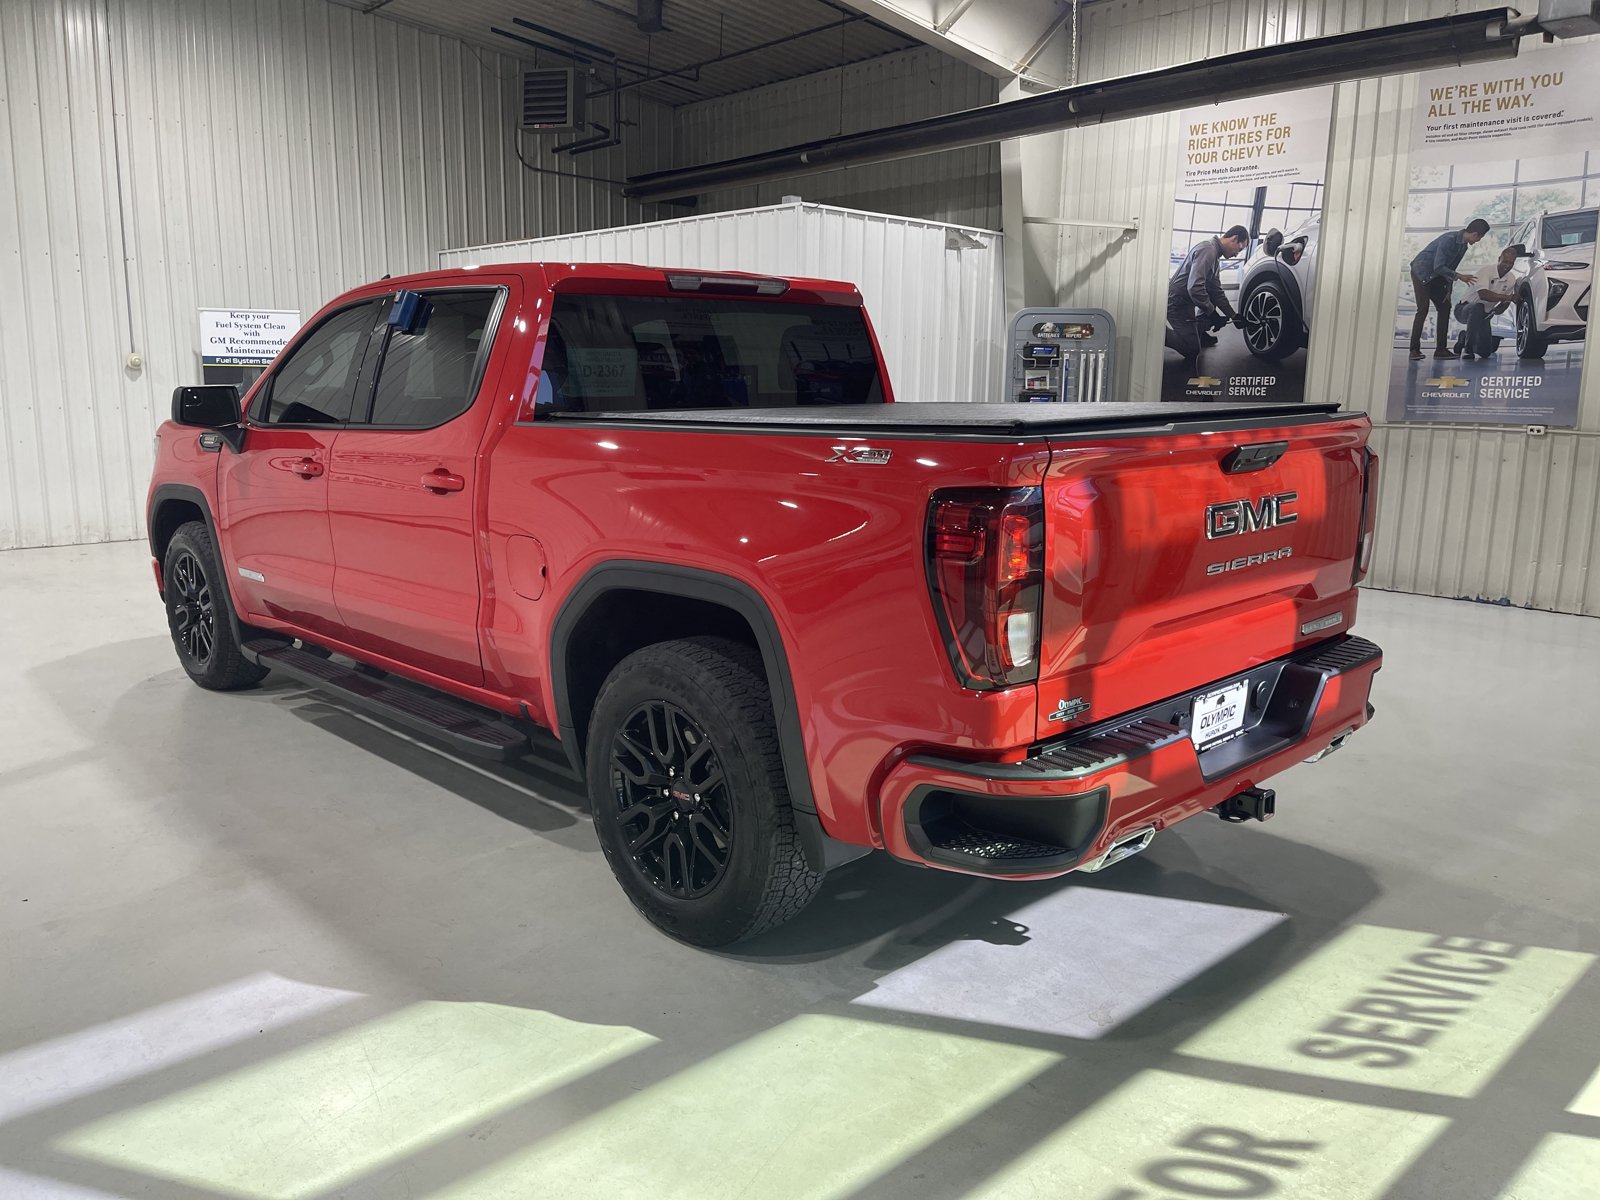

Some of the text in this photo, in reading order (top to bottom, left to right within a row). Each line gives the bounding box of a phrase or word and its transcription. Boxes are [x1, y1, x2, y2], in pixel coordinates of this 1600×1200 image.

[1430, 72, 1564, 101] WE'RE WITH YOU
[1427, 93, 1535, 118] ALL THE WAY.
[1190, 112, 1278, 136] WE KNOW THE
[1460, 118, 1504, 129] maintenance
[1506, 116, 1522, 124] visit
[1188, 126, 1291, 151] RIGHT TIRES FOR
[1187, 142, 1286, 166] YOUR CHEVY EV.
[1212, 167, 1229, 175] Match
[1230, 164, 1260, 173] Guarantee.
[230, 312, 250, 320] Keep
[234, 322, 261, 330] System
[210, 336, 288, 346] GM Recommende
[226, 346, 281, 354] Maintenance
[584, 364, 626, 378] D-2367
[1229, 376, 1276, 386] CERTIFIED
[1480, 376, 1542, 387] CERTIFIED
[1228, 386, 1267, 396] SERVICE
[1479, 388, 1530, 399] SERVICE
[1206, 490, 1298, 540] GMC
[1206, 546, 1292, 576] SIERRA
[1200, 704, 1236, 730] OLYMPIC
[1291, 936, 1522, 1068] SERVICE
